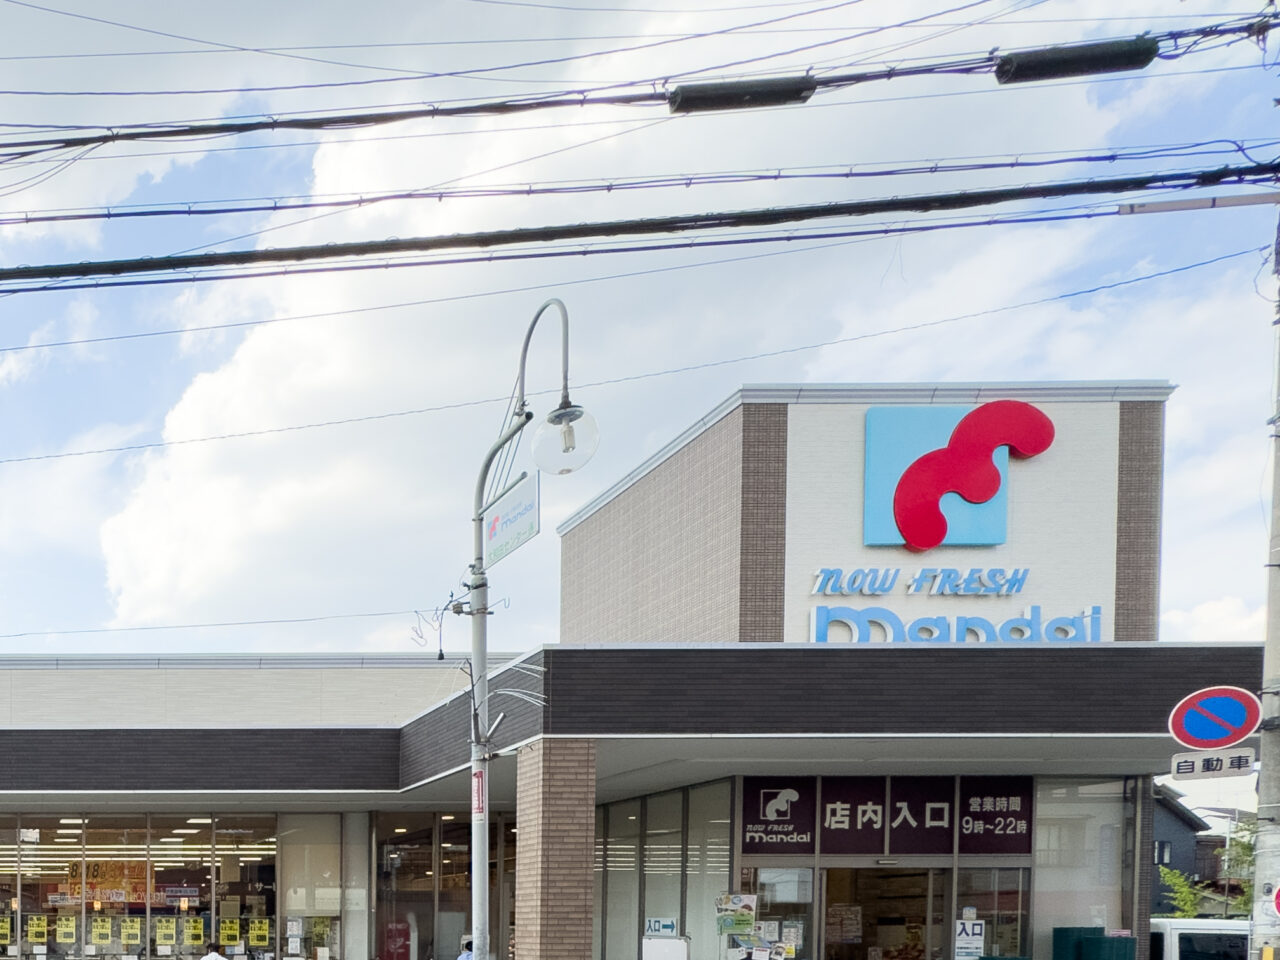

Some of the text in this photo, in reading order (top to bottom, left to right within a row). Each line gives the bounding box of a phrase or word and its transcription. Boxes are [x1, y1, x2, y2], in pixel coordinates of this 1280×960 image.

[908, 568, 1030, 595] FRESH
[812, 605, 1102, 643] mandai
[1176, 755, 1251, 774] 自動車
[969, 797, 1021, 811] 営業時間
[824, 801, 950, 829] 店内入口
[746, 832, 811, 843] mandai
[646, 919, 661, 932] 入口
[957, 922, 983, 937] 入口
